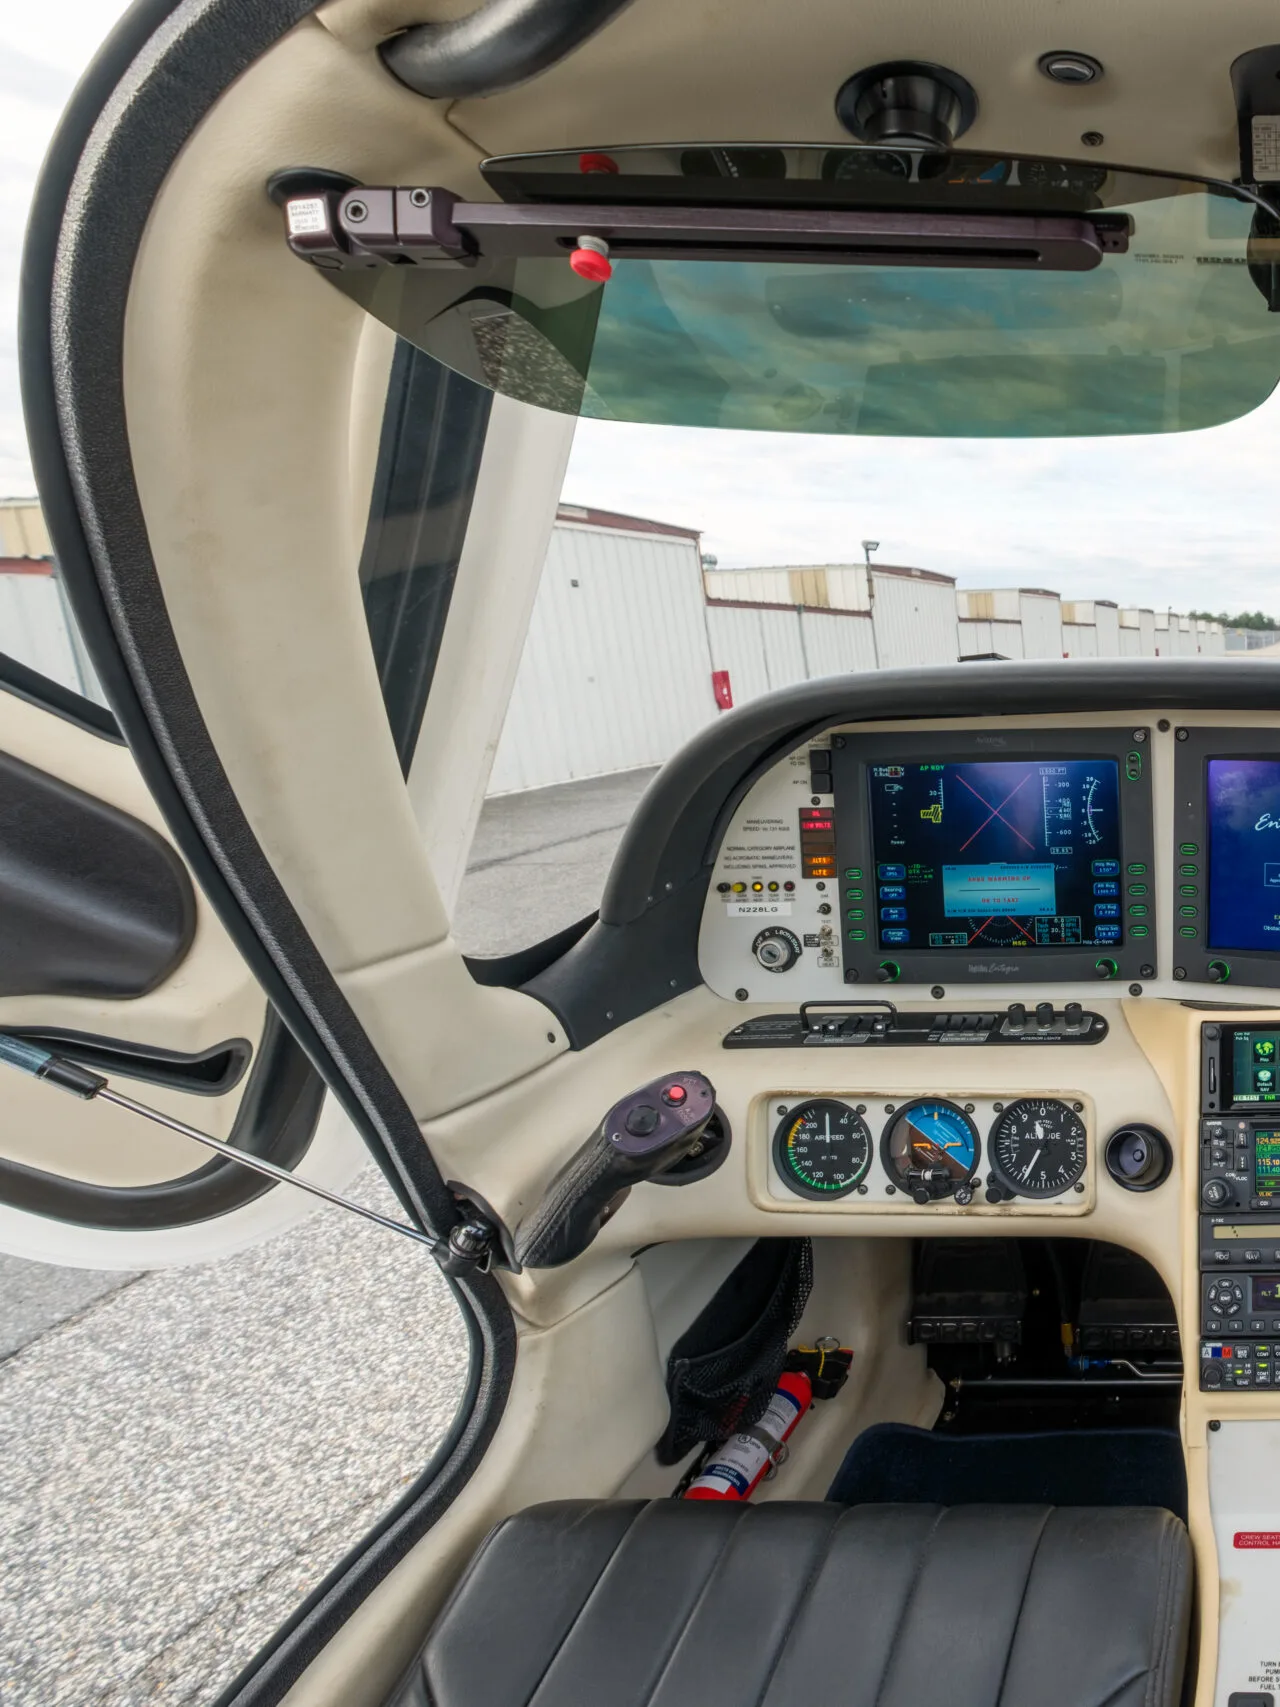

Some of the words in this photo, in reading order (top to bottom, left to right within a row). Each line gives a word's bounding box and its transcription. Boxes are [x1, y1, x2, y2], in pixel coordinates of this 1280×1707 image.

[1040, 1108, 1046, 1116] 0
[1022, 1114, 1028, 1122] 9
[1060, 1114, 1063, 1122] 1
[1071, 1127, 1076, 1135] 2
[1011, 1154, 1016, 1162] 7
[1071, 1152, 1076, 1160] 3
[1058, 1165, 1064, 1173] 4
[1040, 1171, 1046, 1179] 5
